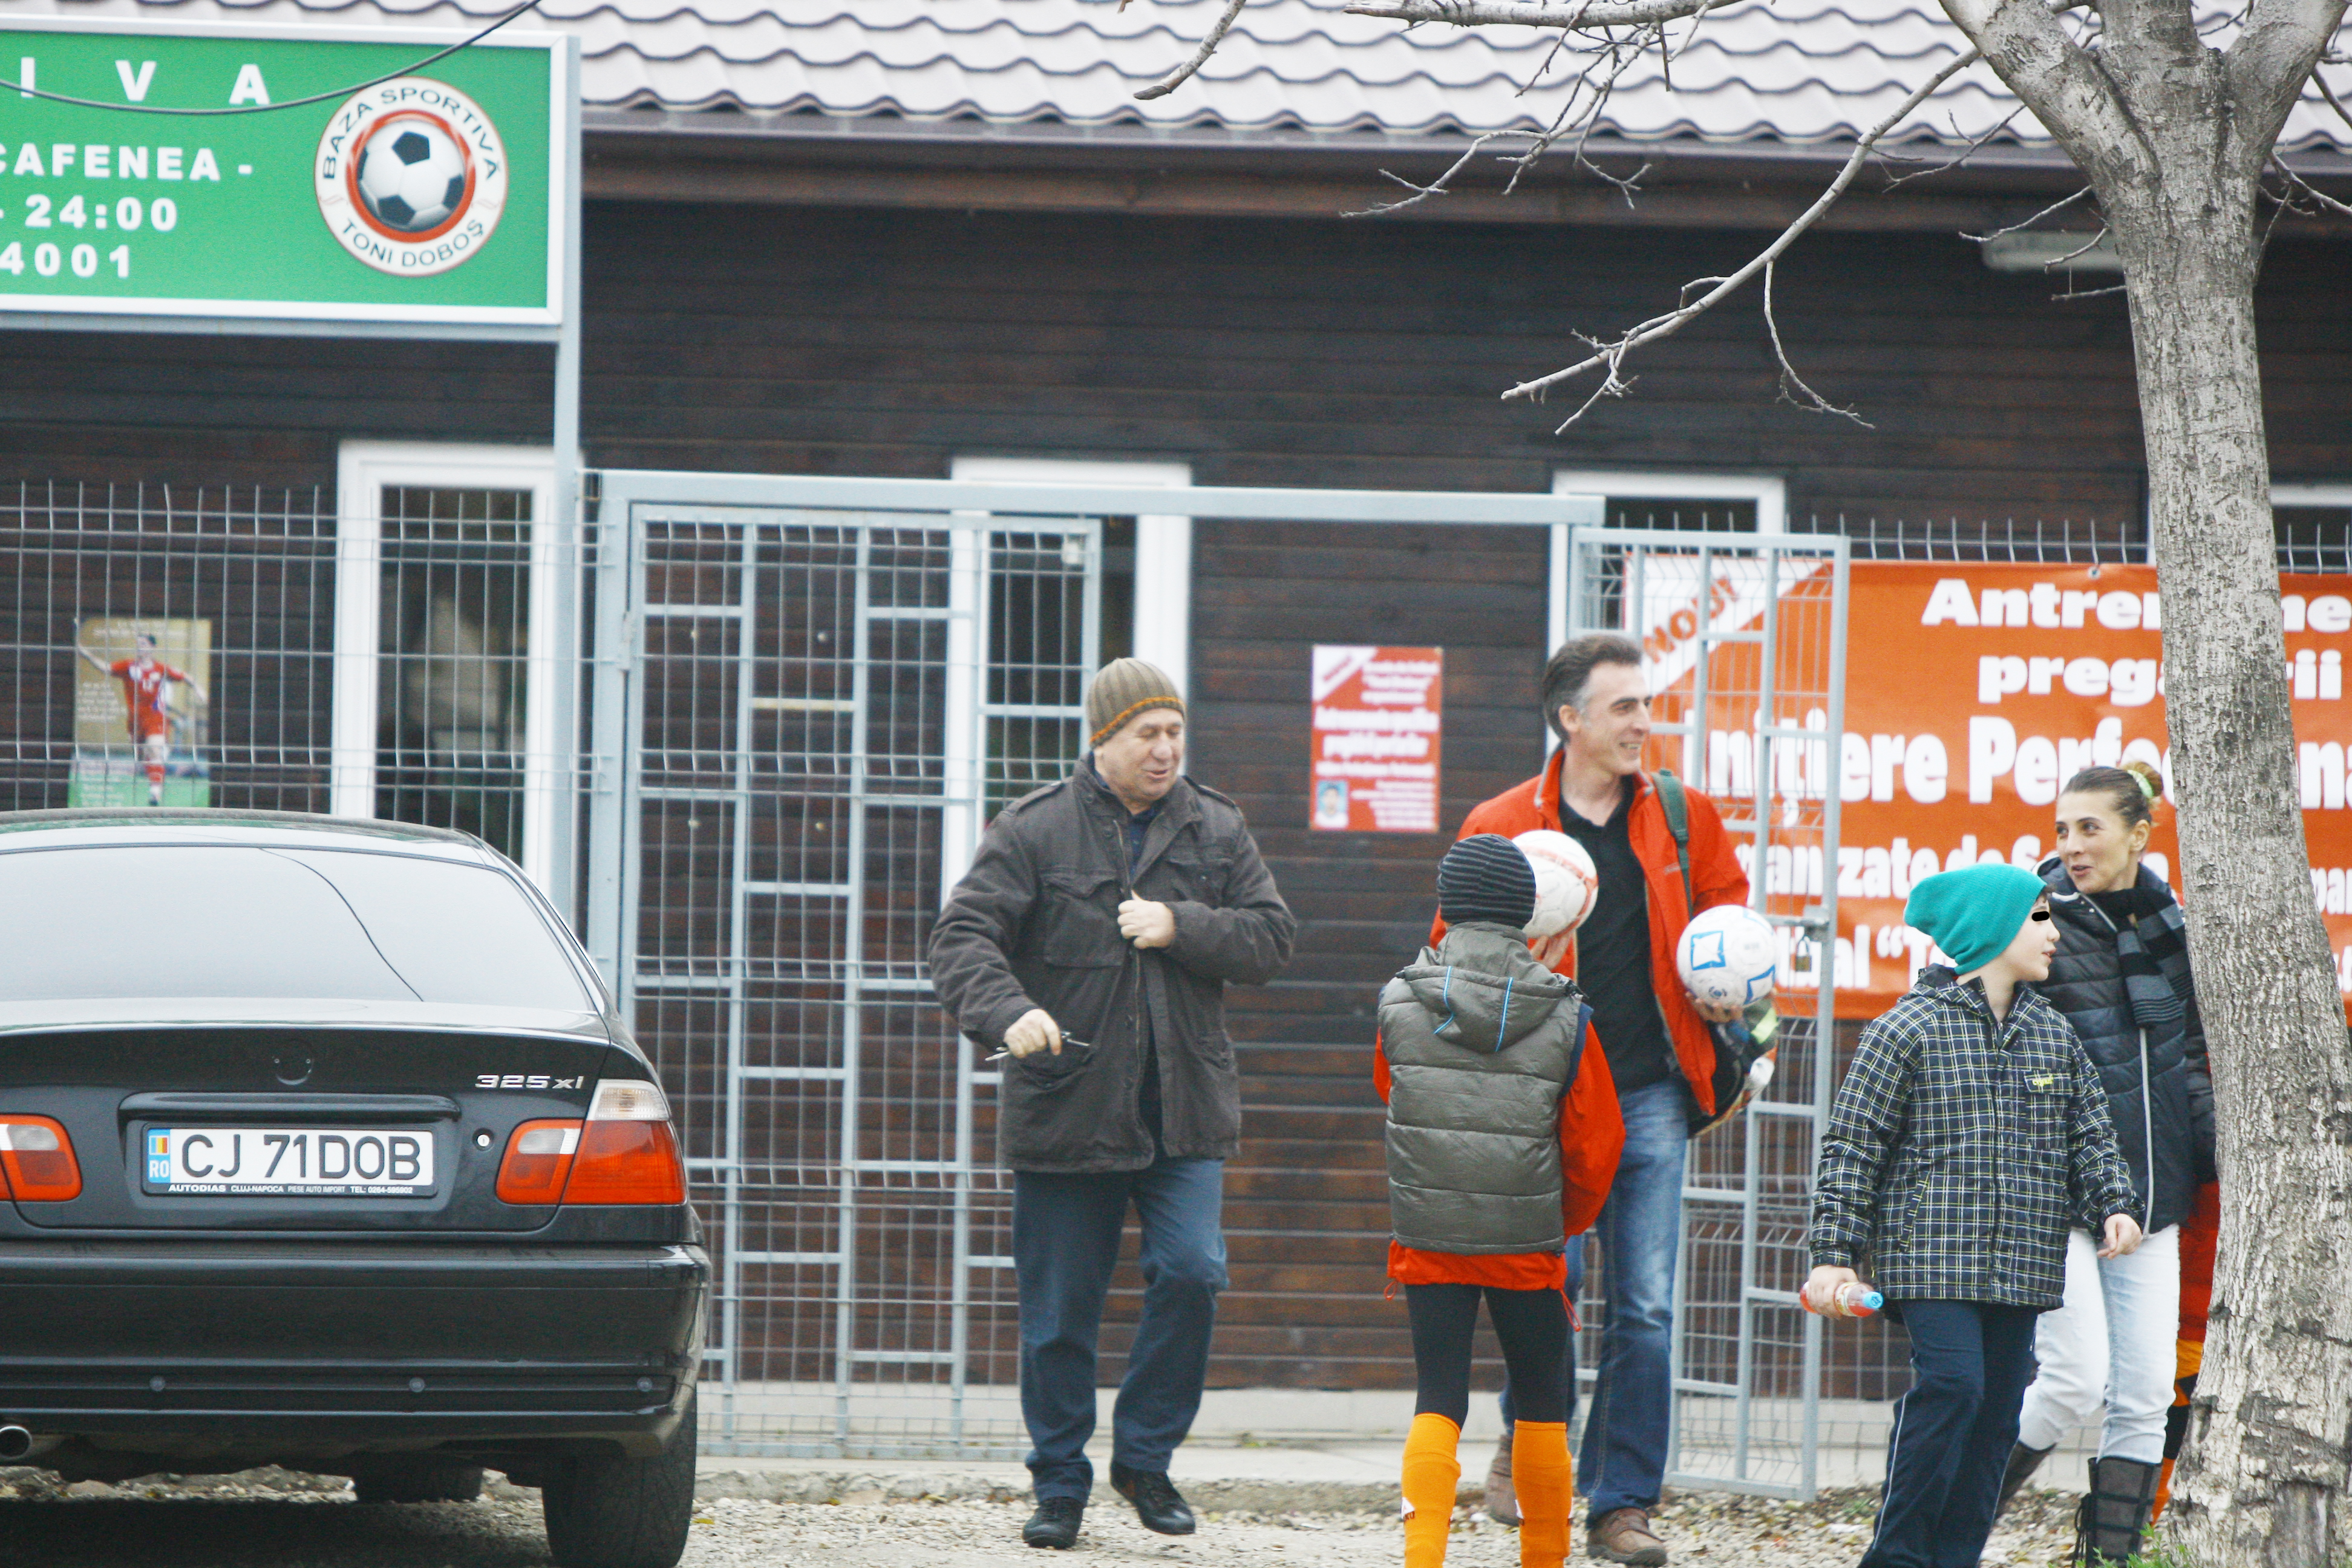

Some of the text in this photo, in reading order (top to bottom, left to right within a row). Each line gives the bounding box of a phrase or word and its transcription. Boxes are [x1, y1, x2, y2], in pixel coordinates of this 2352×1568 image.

[323, 102, 373, 180] BAZA
[0, 143, 220, 181] AFENEA
[24, 194, 177, 232] 24:00
[341, 218, 392, 264] TONI
[0, 242, 130, 279] 4001
[149, 1160, 170, 1178] RO
[181, 1134, 241, 1178] CJ
[168, 1184, 226, 1192] AUTODIAS
